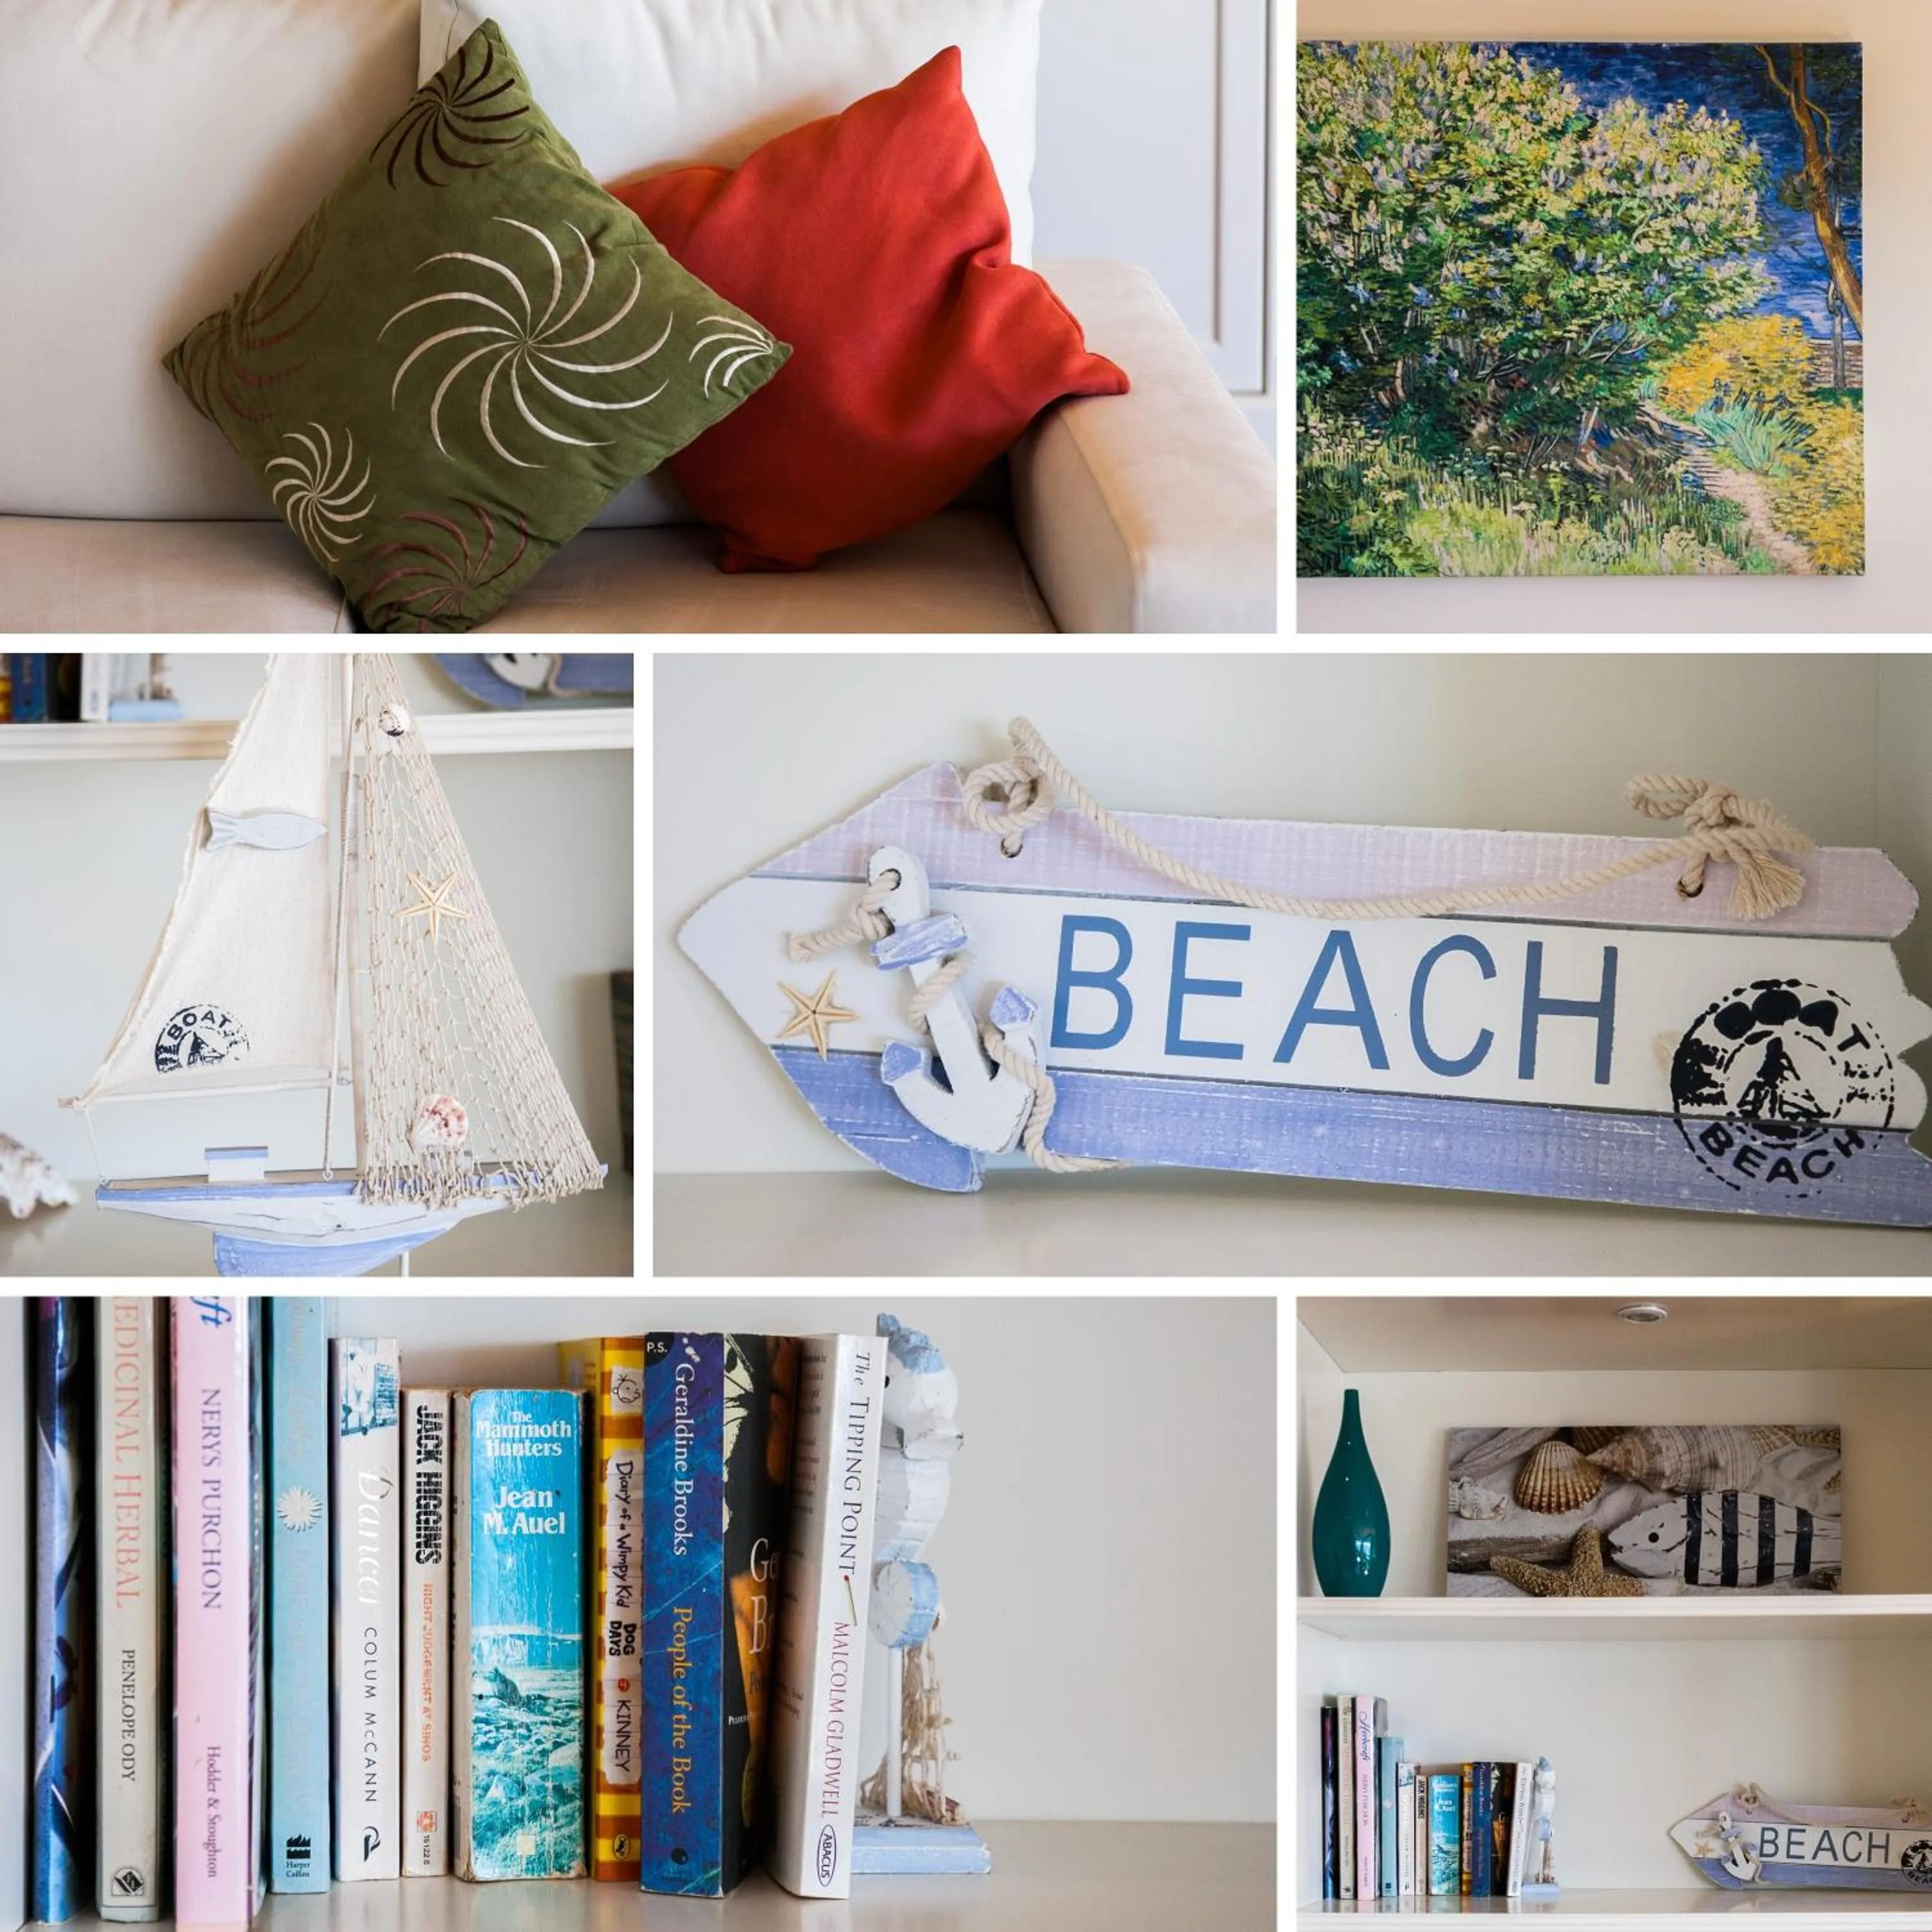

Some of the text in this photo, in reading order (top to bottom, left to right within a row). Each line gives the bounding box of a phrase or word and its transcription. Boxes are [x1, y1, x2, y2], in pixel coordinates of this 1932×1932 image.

[1050, 914, 1618, 1086] BEACH
[1699, 1121, 1866, 1185] BEACH
[189, 1296, 232, 1328] ft
[646, 1342, 668, 1353] P.S.
[476, 1420, 572, 1438] Mammoth
[509, 1411, 533, 1423] The
[113, 1296, 142, 1609] EDICINAL HERBAL
[486, 1439, 563, 1457] Hunters
[674, 1363, 695, 1556] Geraldine Brooks
[838, 1352, 871, 1575] The TIPPING POINT
[201, 1388, 222, 1609] NERYS PURCHON
[415, 1405, 443, 1565] JACK HIGGINS
[496, 1486, 553, 1509] Jean
[615, 1460, 634, 1504] Diary
[482, 1511, 565, 1535] M. Auel
[620, 1508, 632, 1520] of
[612, 1533, 632, 1581] Wimpy
[422, 1583, 433, 1623] NIGHT
[615, 1585, 633, 1607] Kid
[609, 1620, 622, 1657] DAYS
[623, 1622, 637, 1656] DOG
[422, 1625, 433, 1703] JUDGEMENT
[122, 1649, 135, 1782] PENELOPE ODY
[364, 1627, 377, 1803] COLUM McCANN
[667, 1606, 693, 1814] People of the Book
[820, 1621, 850, 1819] MALCOLM GLADWELL
[615, 1700, 631, 1772] KINNEY
[205, 1745, 220, 1878] Hodder & Stoughton
[820, 1833, 833, 1880] ABACUS
[1759, 1826, 1889, 1864] BEACH
